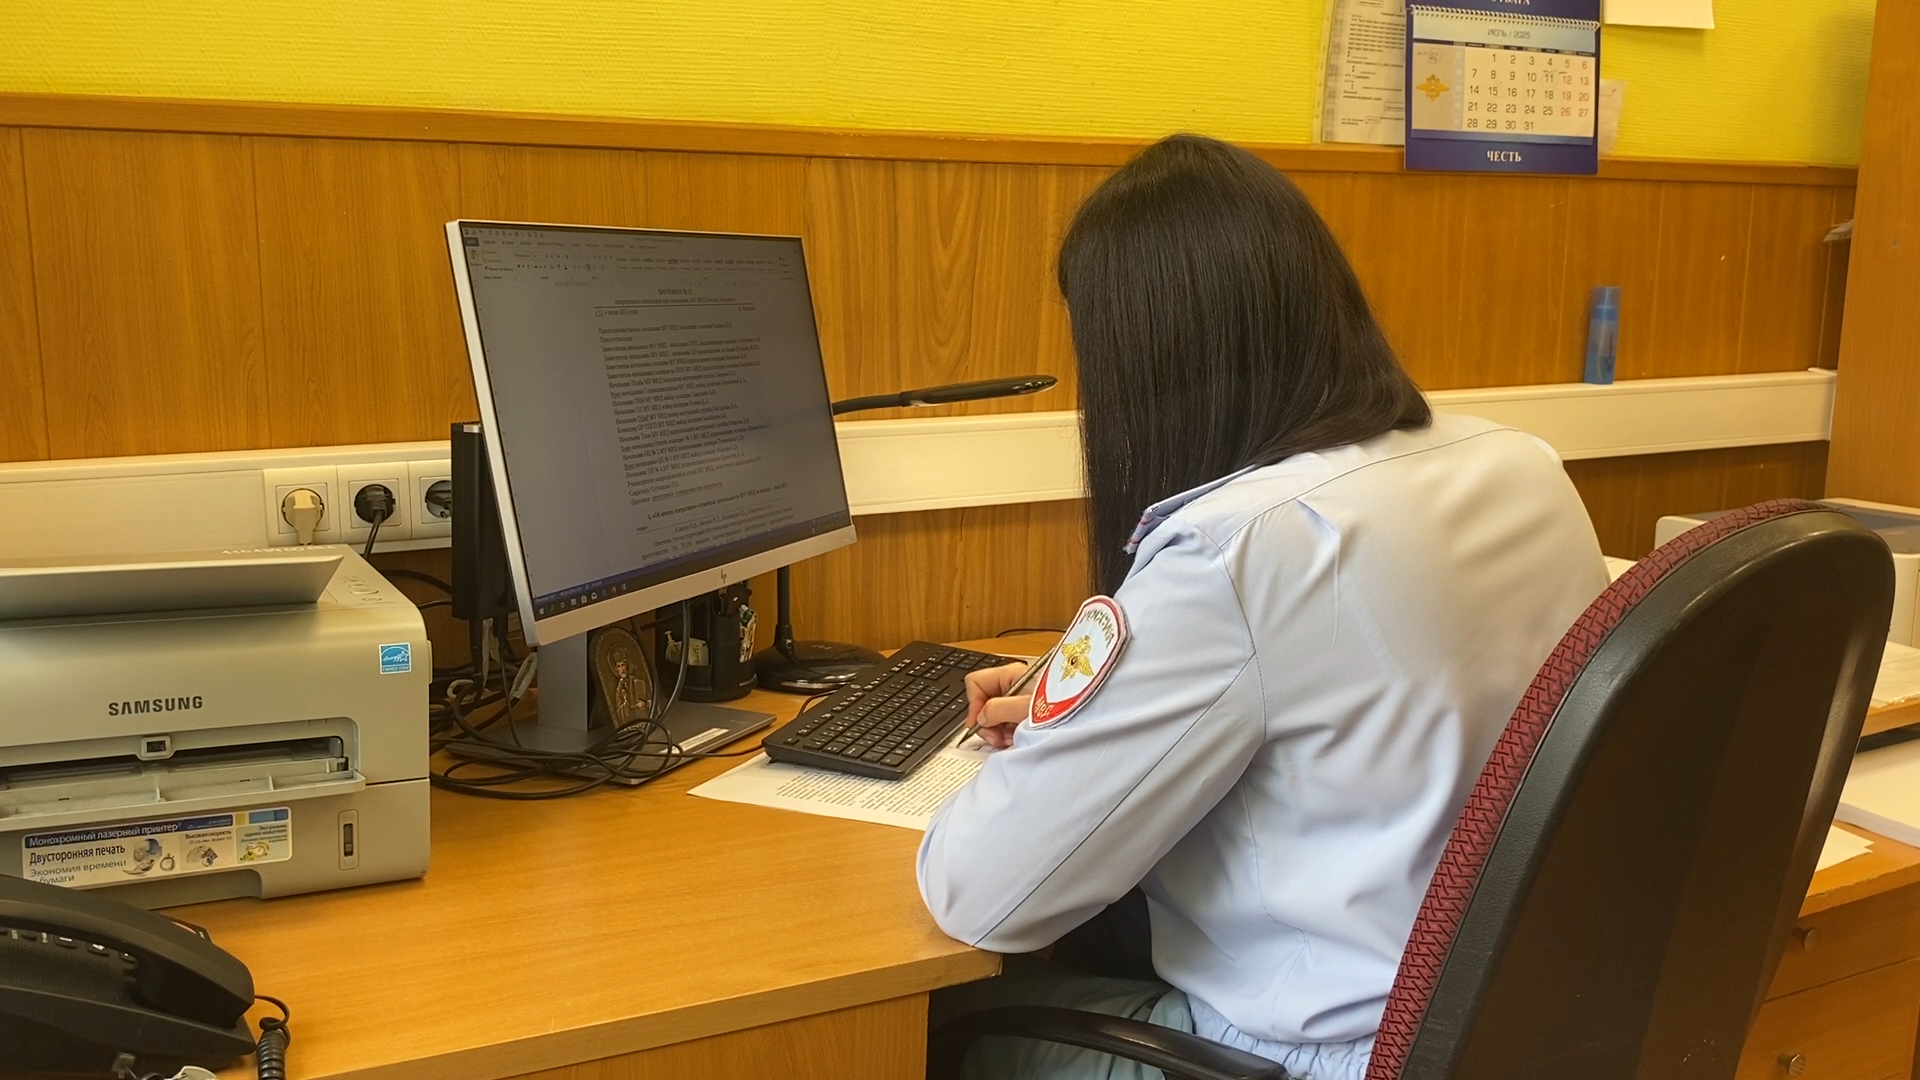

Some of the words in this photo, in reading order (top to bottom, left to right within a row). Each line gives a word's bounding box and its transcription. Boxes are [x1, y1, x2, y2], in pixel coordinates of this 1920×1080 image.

[1487, 28, 1507, 37] ИЮЛЬ
[1513, 30, 1531, 39] 2025
[1492, 54, 1496, 63] 1
[1510, 55, 1516, 64] 2
[1529, 56, 1534, 65] 3
[1547, 58, 1552, 66] 4
[1565, 59, 1570, 68] 5
[1582, 61, 1587, 70] 6
[1472, 68, 1477, 77] 7
[1491, 70, 1496, 79] 8
[1510, 71, 1515, 80] 9
[1527, 73, 1536, 82] 10
[1544, 73, 1553, 83] 11
[1563, 76, 1572, 84] 12
[1580, 77, 1589, 86] 13
[1470, 85, 1479, 94] 14
[1489, 87, 1498, 96] 15
[1508, 88, 1517, 97] 16
[1527, 89, 1536, 97] 17
[1545, 90, 1553, 99] 18
[1562, 91, 1571, 100] 19
[1579, 92, 1589, 101] 20
[1468, 102, 1477, 111] 21
[1487, 103, 1497, 112] 22
[1506, 104, 1516, 113] 23
[1525, 105, 1535, 114] 24
[1543, 106, 1553, 115] 25
[1561, 107, 1570, 116] 26
[1579, 108, 1588, 117] 27
[1467, 118, 1477, 128] 28
[1486, 119, 1497, 128] 29
[1505, 120, 1516, 129] 30
[1524, 121, 1533, 130] 31
[1486, 150, 1522, 162] ЧЕСТЬ
[108, 695, 203, 716] SAMSUNG
[1034, 696, 1053, 719] МВД
[29, 833, 96, 847] Монохромный
[97, 827, 141, 840] лазерный
[141, 824, 178, 837] принтер
[29, 848, 93, 866] Двусторонняя
[95, 844, 126, 857] печать
[30, 863, 81, 878] Экономия
[84, 859, 127, 872] времени
[39, 874, 75, 885] бумаги
